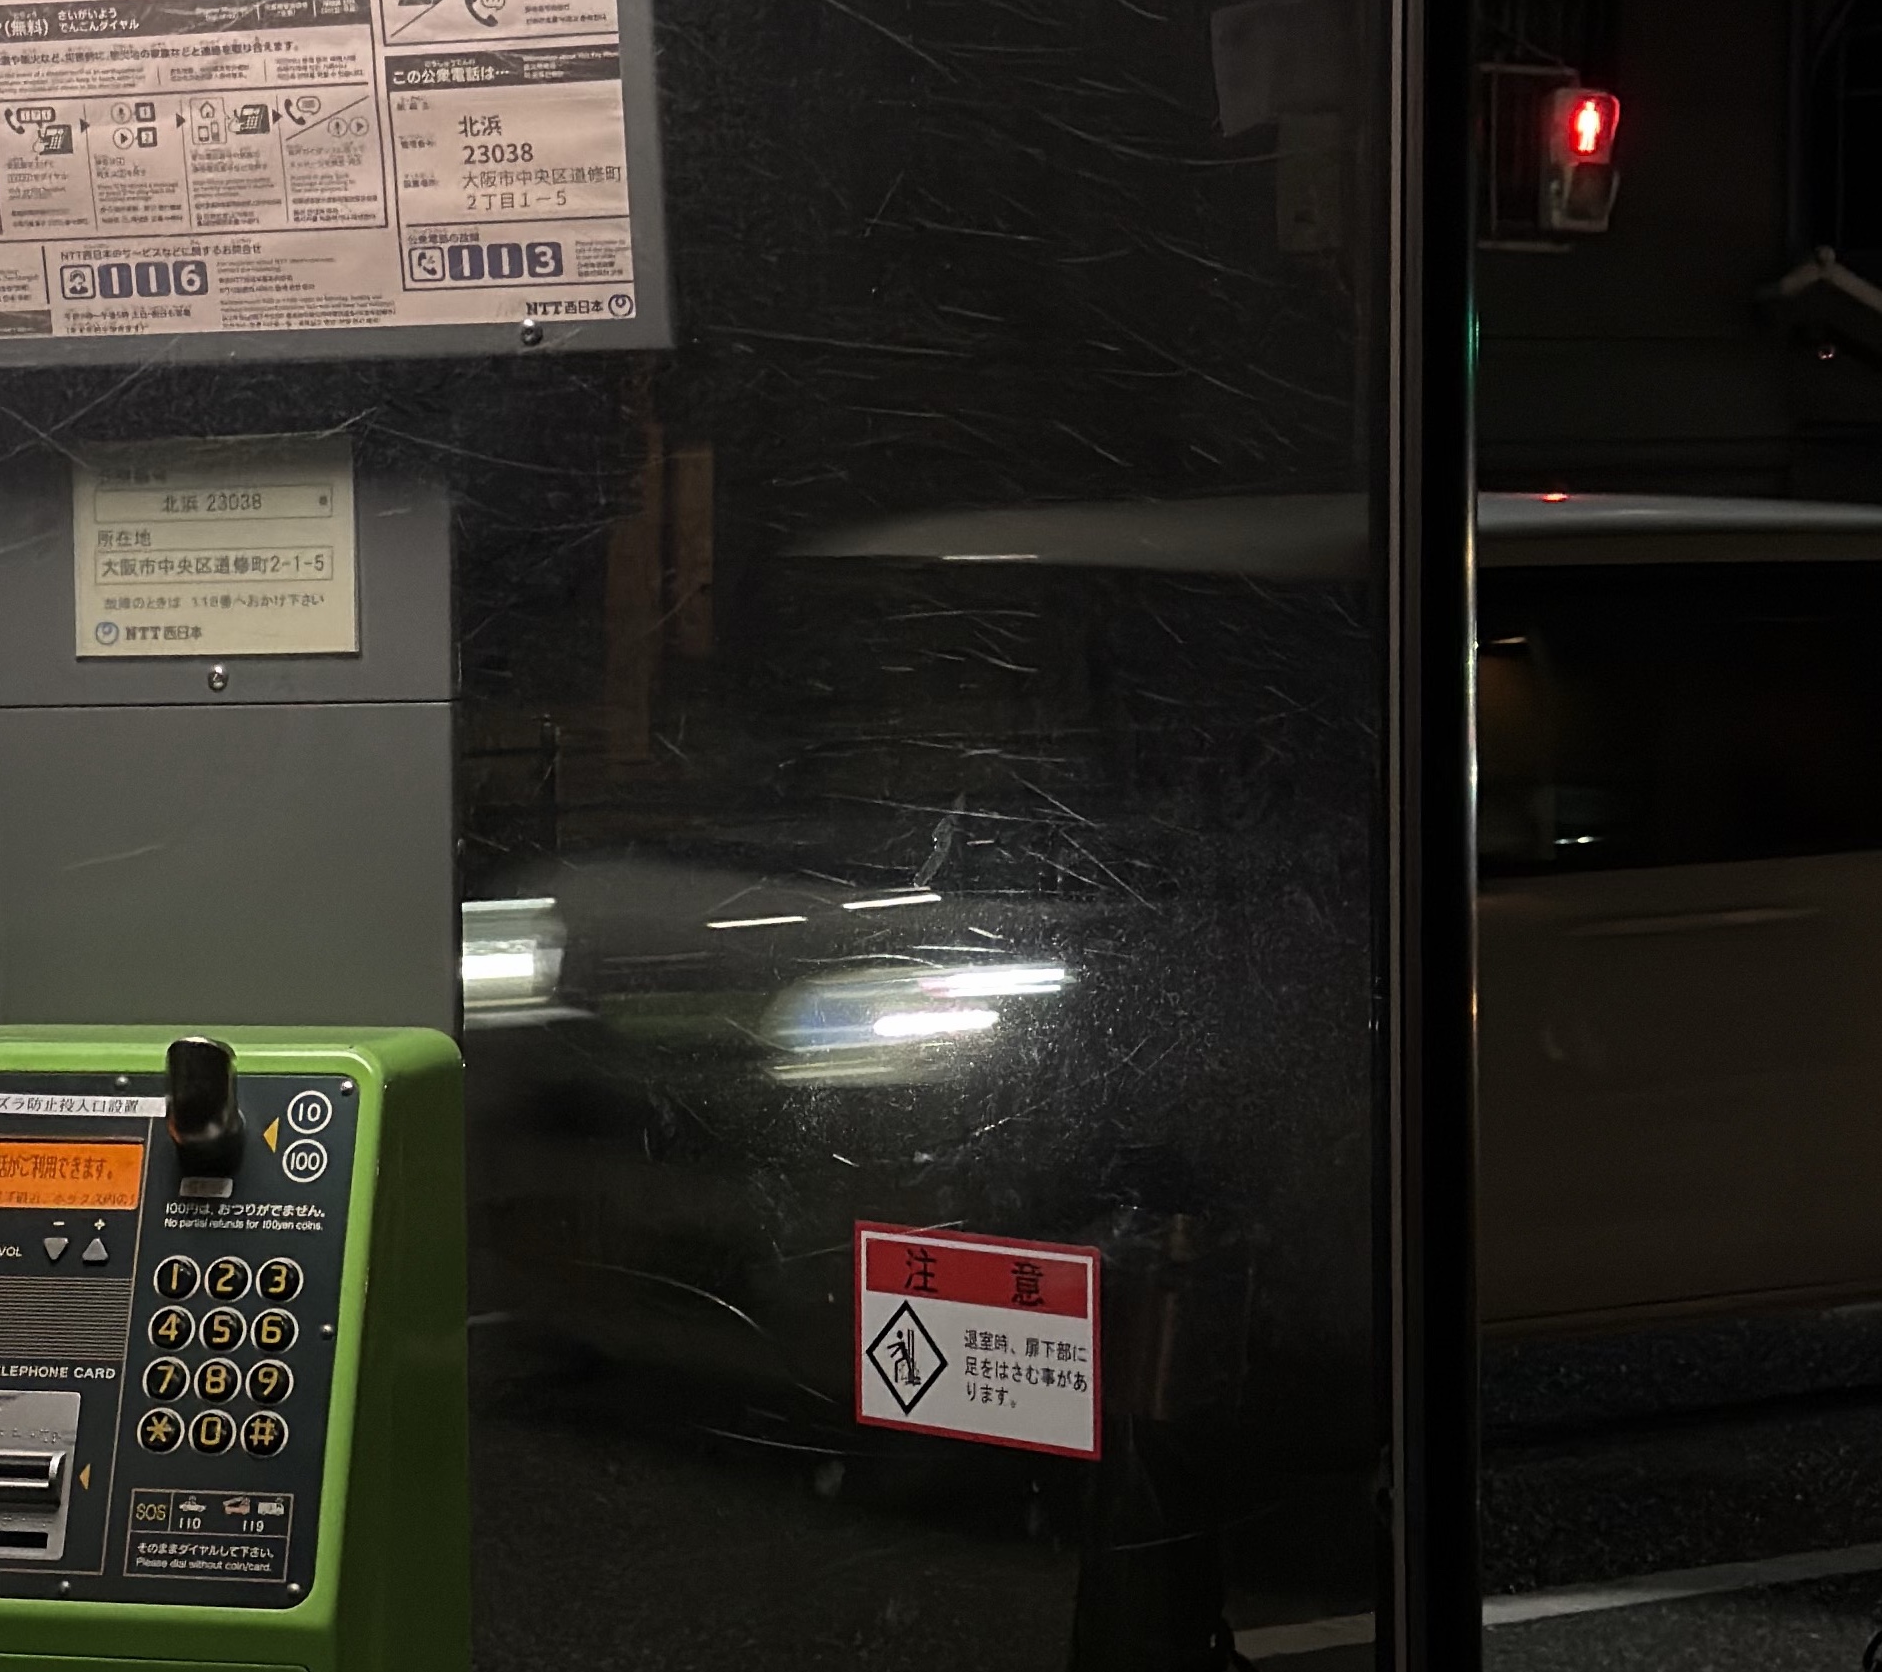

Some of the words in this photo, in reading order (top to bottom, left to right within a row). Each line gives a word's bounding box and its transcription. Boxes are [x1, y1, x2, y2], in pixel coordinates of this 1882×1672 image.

[458, 115, 502, 138] 北浜
[463, 142, 534, 165] 23038
[462, 165, 621, 190] 大阪市中央区道修町
[461, 246, 555, 277] 113
[111, 263, 201, 294] 116
[525, 300, 604, 316] NTT西日本
[162, 496, 199, 513] 北浜
[207, 493, 262, 512] 23038
[98, 530, 152, 547] 所在地
[126, 626, 202, 641] NTT西日本
[299, 1103, 320, 1122] 10
[290, 1151, 320, 1171] 100
[165, 1218, 177, 1228] No
[180, 1218, 208, 1229] partial
[209, 1218, 244, 1229] refunds
[246, 1219, 260, 1229] for
[296, 1221, 324, 1231] coins.
[171, 1263, 180, 1291] 1
[216, 1263, 235, 1292] 2
[268, 1265, 287, 1293] 3
[158, 1313, 179, 1341] 4
[212, 1315, 231, 1343] 5
[261, 1316, 283, 1344] 6
[964, 1329, 1088, 1363] 退室時、扉下部に
[74, 1367, 116, 1380] CARD
[156, 1366, 174, 1394] 7
[205, 1365, 226, 1394] 8
[258, 1367, 278, 1396] 9
[964, 1356, 1088, 1393] 足をはさむ事があ
[966, 1381, 1017, 1409] ります。
[200, 1417, 222, 1446] 0
[249, 1418, 275, 1446] #
[136, 1503, 166, 1521] SOS
[179, 1518, 201, 1530] 110
[242, 1520, 264, 1533] 119
[136, 1557, 168, 1569] Please
[170, 1558, 187, 1569] dial
[189, 1559, 222, 1570] without
